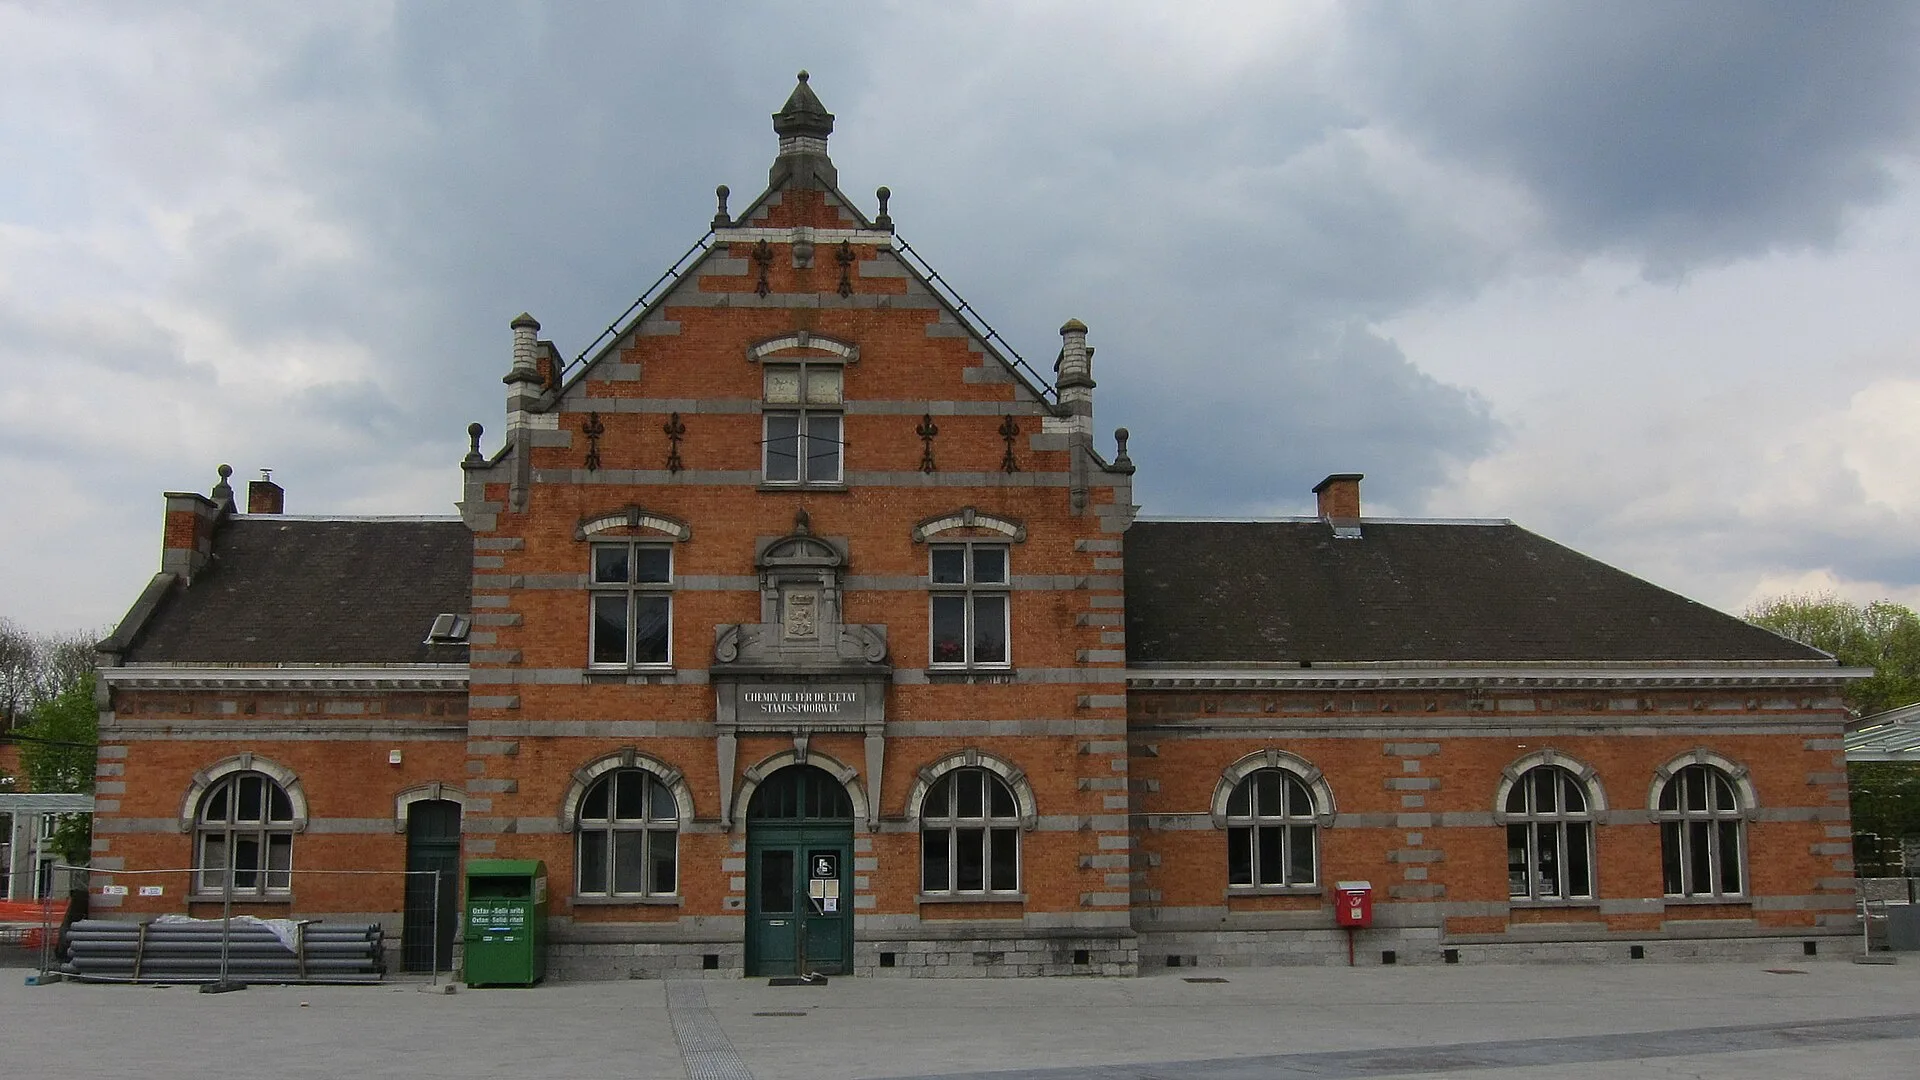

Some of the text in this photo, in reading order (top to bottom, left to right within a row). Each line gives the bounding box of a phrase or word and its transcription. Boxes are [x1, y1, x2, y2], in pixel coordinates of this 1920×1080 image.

[744, 692, 857, 702] CHEMIN DE FER DE L'ETAT
[760, 703, 841, 713] STAATSSPOORWEG
